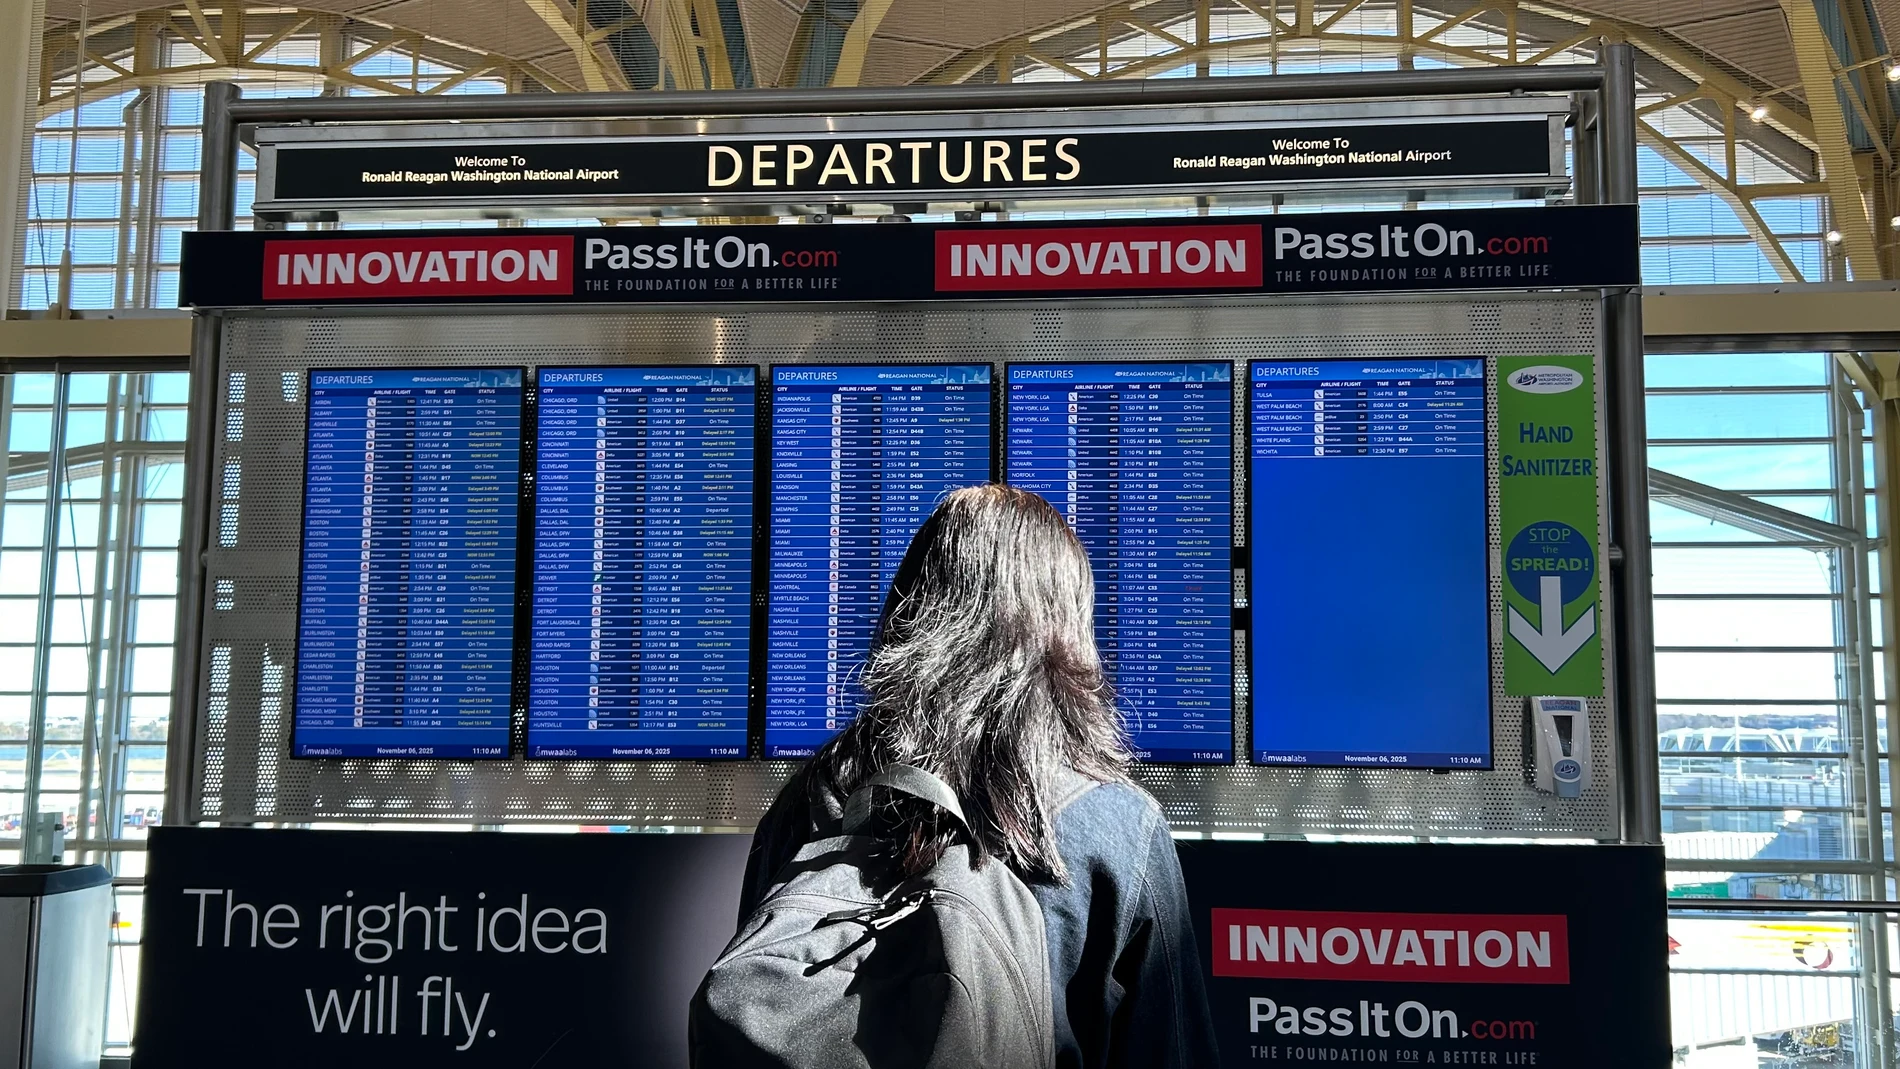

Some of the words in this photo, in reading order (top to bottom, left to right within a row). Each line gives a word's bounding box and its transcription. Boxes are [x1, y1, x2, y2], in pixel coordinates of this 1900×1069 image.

[1272, 139, 1330, 150] Welcome
[1333, 138, 1349, 148] To
[455, 156, 508, 166] Welcome
[511, 156, 526, 166] To
[706, 138, 1081, 187] DEPARTURES
[1174, 156, 1216, 168] Ronald
[1220, 156, 1265, 169] Reagan
[1269, 153, 1344, 166] Washington
[1349, 150, 1402, 163] National
[1406, 150, 1451, 163] Airport
[362, 171, 400, 182] Ronald
[400, 171, 448, 184] Reagan
[451, 170, 520, 183] Washington
[524, 169, 573, 180] National
[576, 169, 618, 182] Airport
[951, 240, 1246, 276] INNOVATION
[278, 250, 558, 284] INNOVATION
[1276, 271, 1301, 282] THE
[1311, 268, 1406, 281] FOUNDATION
[1416, 268, 1436, 279] FOR
[1444, 267, 1452, 278] A
[1460, 266, 1510, 278] BETTER
[1520, 265, 1548, 276] LIFE
[585, 280, 608, 290] THE
[618, 279, 706, 290] FOUNDATION
[715, 279, 734, 289] FOR
[742, 279, 748, 289] A
[756, 278, 802, 289] BETTER
[811, 278, 836, 288] LIFE
[544, 374, 603, 382] DEPARTURES
[779, 372, 837, 380] DEPARTURES
[1014, 370, 1073, 378] DEPARTURES
[1257, 367, 1319, 376] DEPARTURES
[316, 376, 373, 384] DEPARTURES
[1520, 423, 1573, 443] HAND
[1502, 455, 1592, 476] SANITIZER
[1529, 528, 1570, 541] STOP
[1542, 545, 1558, 553] the
[1512, 558, 1588, 570] SPREAD!
[184, 889, 300, 948] The
[320, 890, 458, 963] right
[477, 892, 606, 954] idea
[1230, 925, 1550, 967] INNOVATION
[306, 974, 398, 1034] will
[417, 976, 496, 1050] fly.
[1251, 1046, 1277, 1058] THE
[1287, 1047, 1387, 1062] FOUNDATION
[1397, 1050, 1418, 1060] FOR
[1427, 1051, 1435, 1063] A
[1444, 1051, 1496, 1064] BETTER
[1506, 1052, 1535, 1064] LIFE
